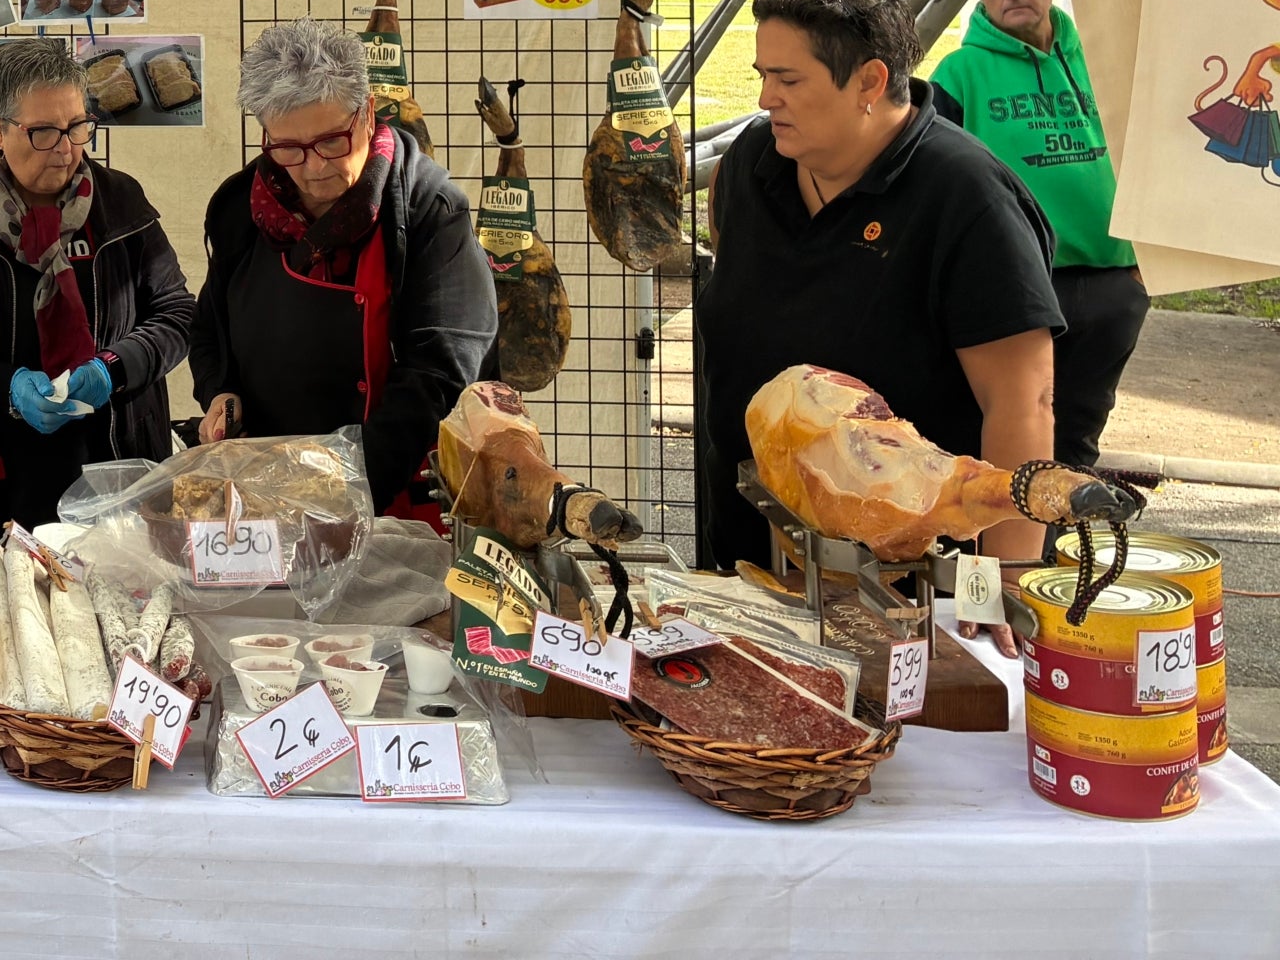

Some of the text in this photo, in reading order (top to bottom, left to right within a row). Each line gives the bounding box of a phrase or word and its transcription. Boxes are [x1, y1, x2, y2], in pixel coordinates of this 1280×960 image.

[365, 46, 396, 61] EGADO
[619, 70, 655, 87] LEGADO
[615, 111, 648, 121] SERIE
[1027, 121, 1060, 130] SINCE
[1044, 133, 1086, 153] 50th
[1040, 152, 1096, 165] ANNIVERSARY
[485, 190, 523, 206] LEGADO
[476, 230, 530, 241] SERIE ORO
[458, 558, 494, 578] PALETA
[485, 542, 542, 602] LEGADO
[541, 622, 602, 656] 6'90
[1072, 629, 1089, 640] 1350
[1084, 643, 1097, 653] 760
[1146, 632, 1195, 673] 18'9
[483, 663, 494, 671] EN
[494, 665, 522, 678] ESPAÑA
[890, 647, 923, 686] 3'99
[508, 675, 538, 688] MUNDO
[559, 663, 627, 693] Carnisseria Cobo
[328, 687, 344, 697] obo
[123, 675, 182, 728] 19'90
[1094, 735, 1112, 745] 1350
[159, 743, 174, 759] Cobo
[291, 746, 331, 775] Carnisseria
[330, 734, 351, 752] Cobo
[1106, 748, 1121, 759] 760
[1146, 760, 1190, 777] CONFIT DE
[393, 781, 462, 792] Carnisseria Cobo
